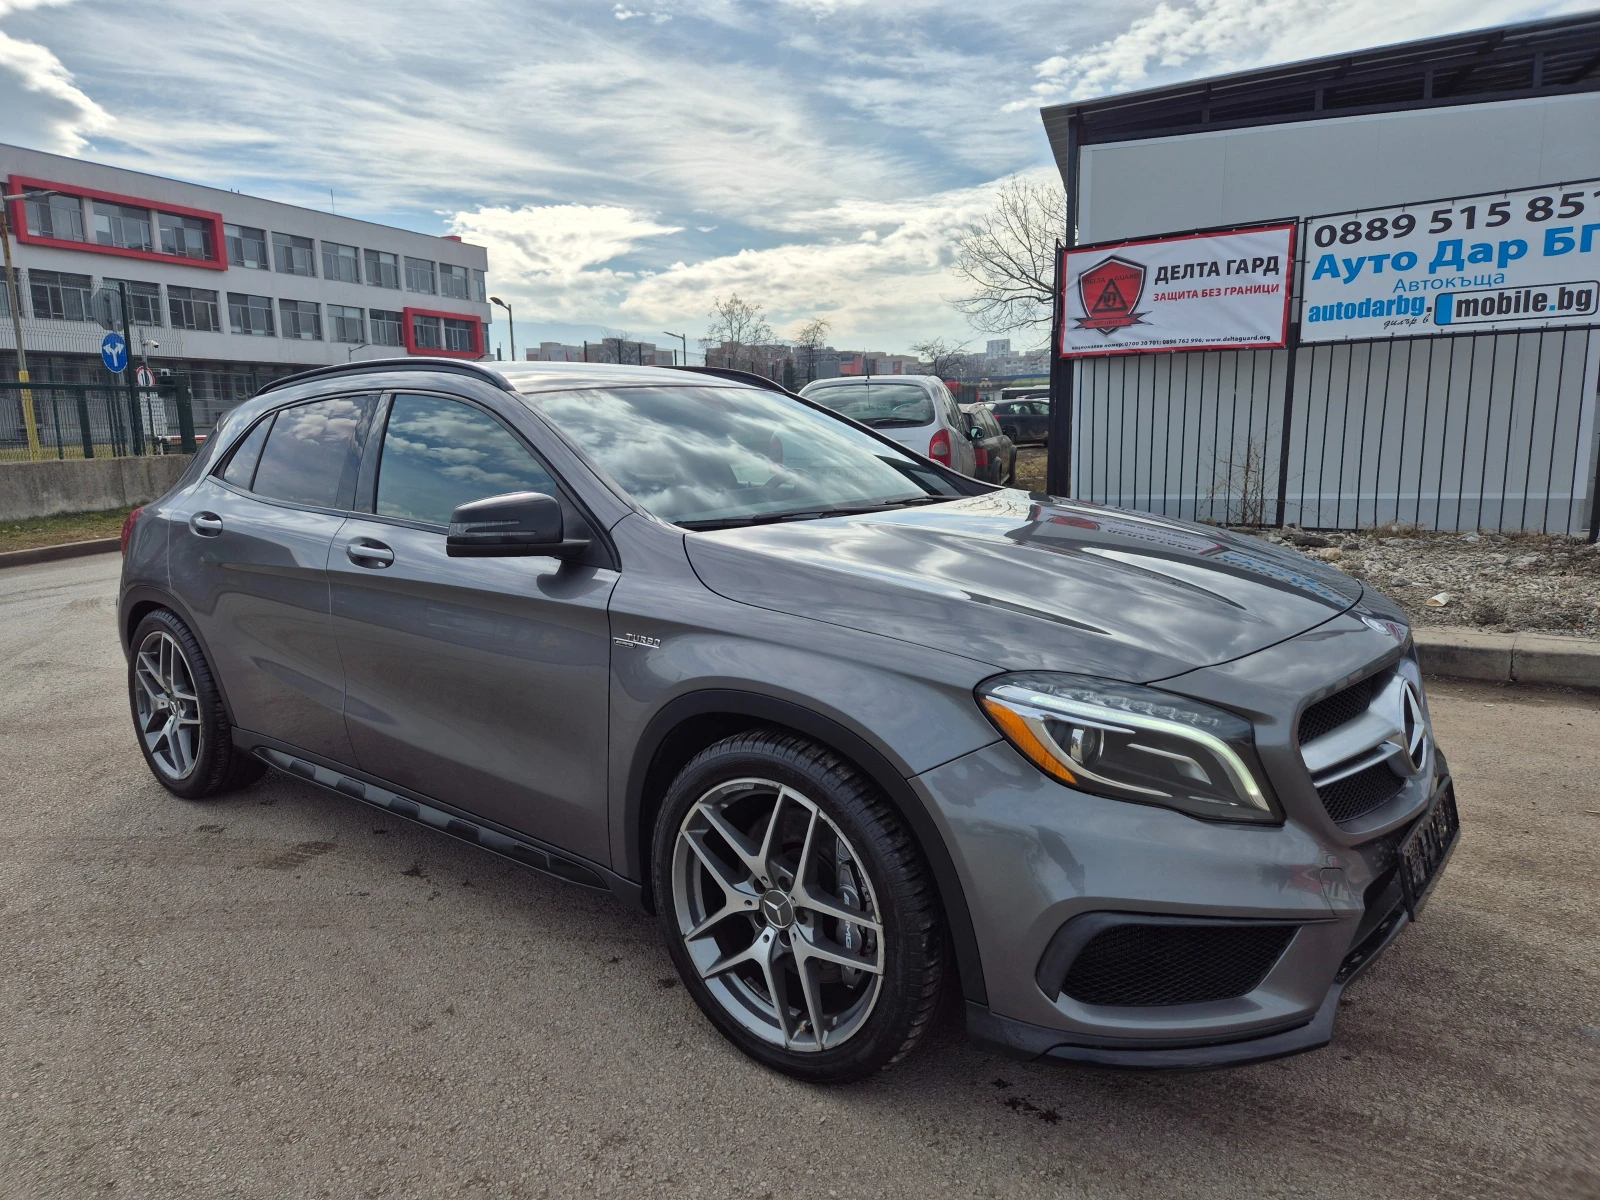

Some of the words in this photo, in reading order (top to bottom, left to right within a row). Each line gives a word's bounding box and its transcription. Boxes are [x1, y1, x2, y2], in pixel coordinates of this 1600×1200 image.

[1314, 213, 1416, 248] 0889
[1428, 200, 1511, 234] 515
[1154, 261, 1220, 285] ДЕЛТА
[1226, 255, 1280, 277] ГАРД
[1311, 251, 1418, 285] Ауто
[1428, 238, 1529, 274] Дар
[1084, 277, 1106, 285] DELTA
[1114, 273, 1140, 281] GUARD
[1392, 272, 1505, 294] Автокъща
[1153, 289, 1199, 302] ЗАЩИТА
[1201, 287, 1222, 298] БЕЗ
[1224, 283, 1280, 296] ГРАНИЦИ
[1455, 286, 1593, 318] mobile.bg
[1383, 316, 1418, 330] дилър
[1205, 335, 1271, 343] www.deltaguard.org
[625, 632, 661, 646] TURBO
